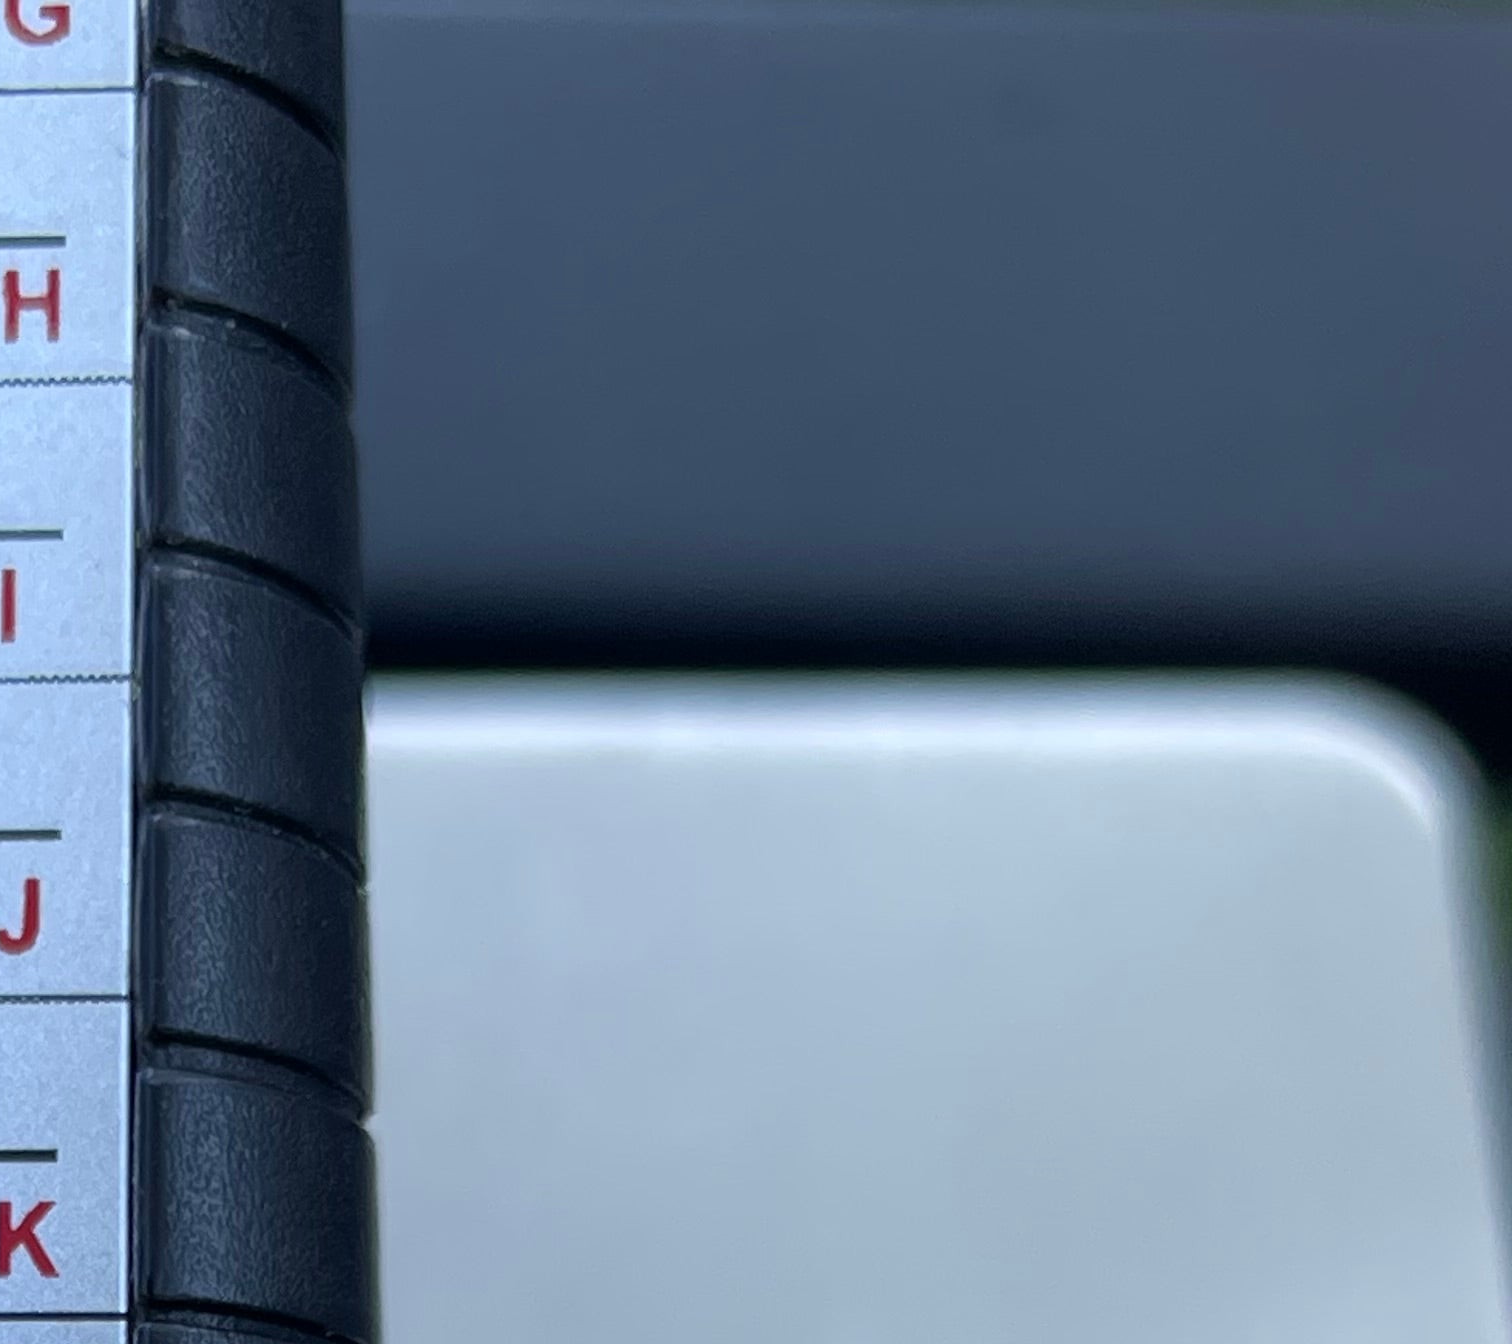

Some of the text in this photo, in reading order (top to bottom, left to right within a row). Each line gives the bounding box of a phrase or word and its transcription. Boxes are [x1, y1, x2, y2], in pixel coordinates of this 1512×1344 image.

[5, 0, 70, 46] G
[3, 268, 61, 343] H
[1, 568, 16, 642] I
